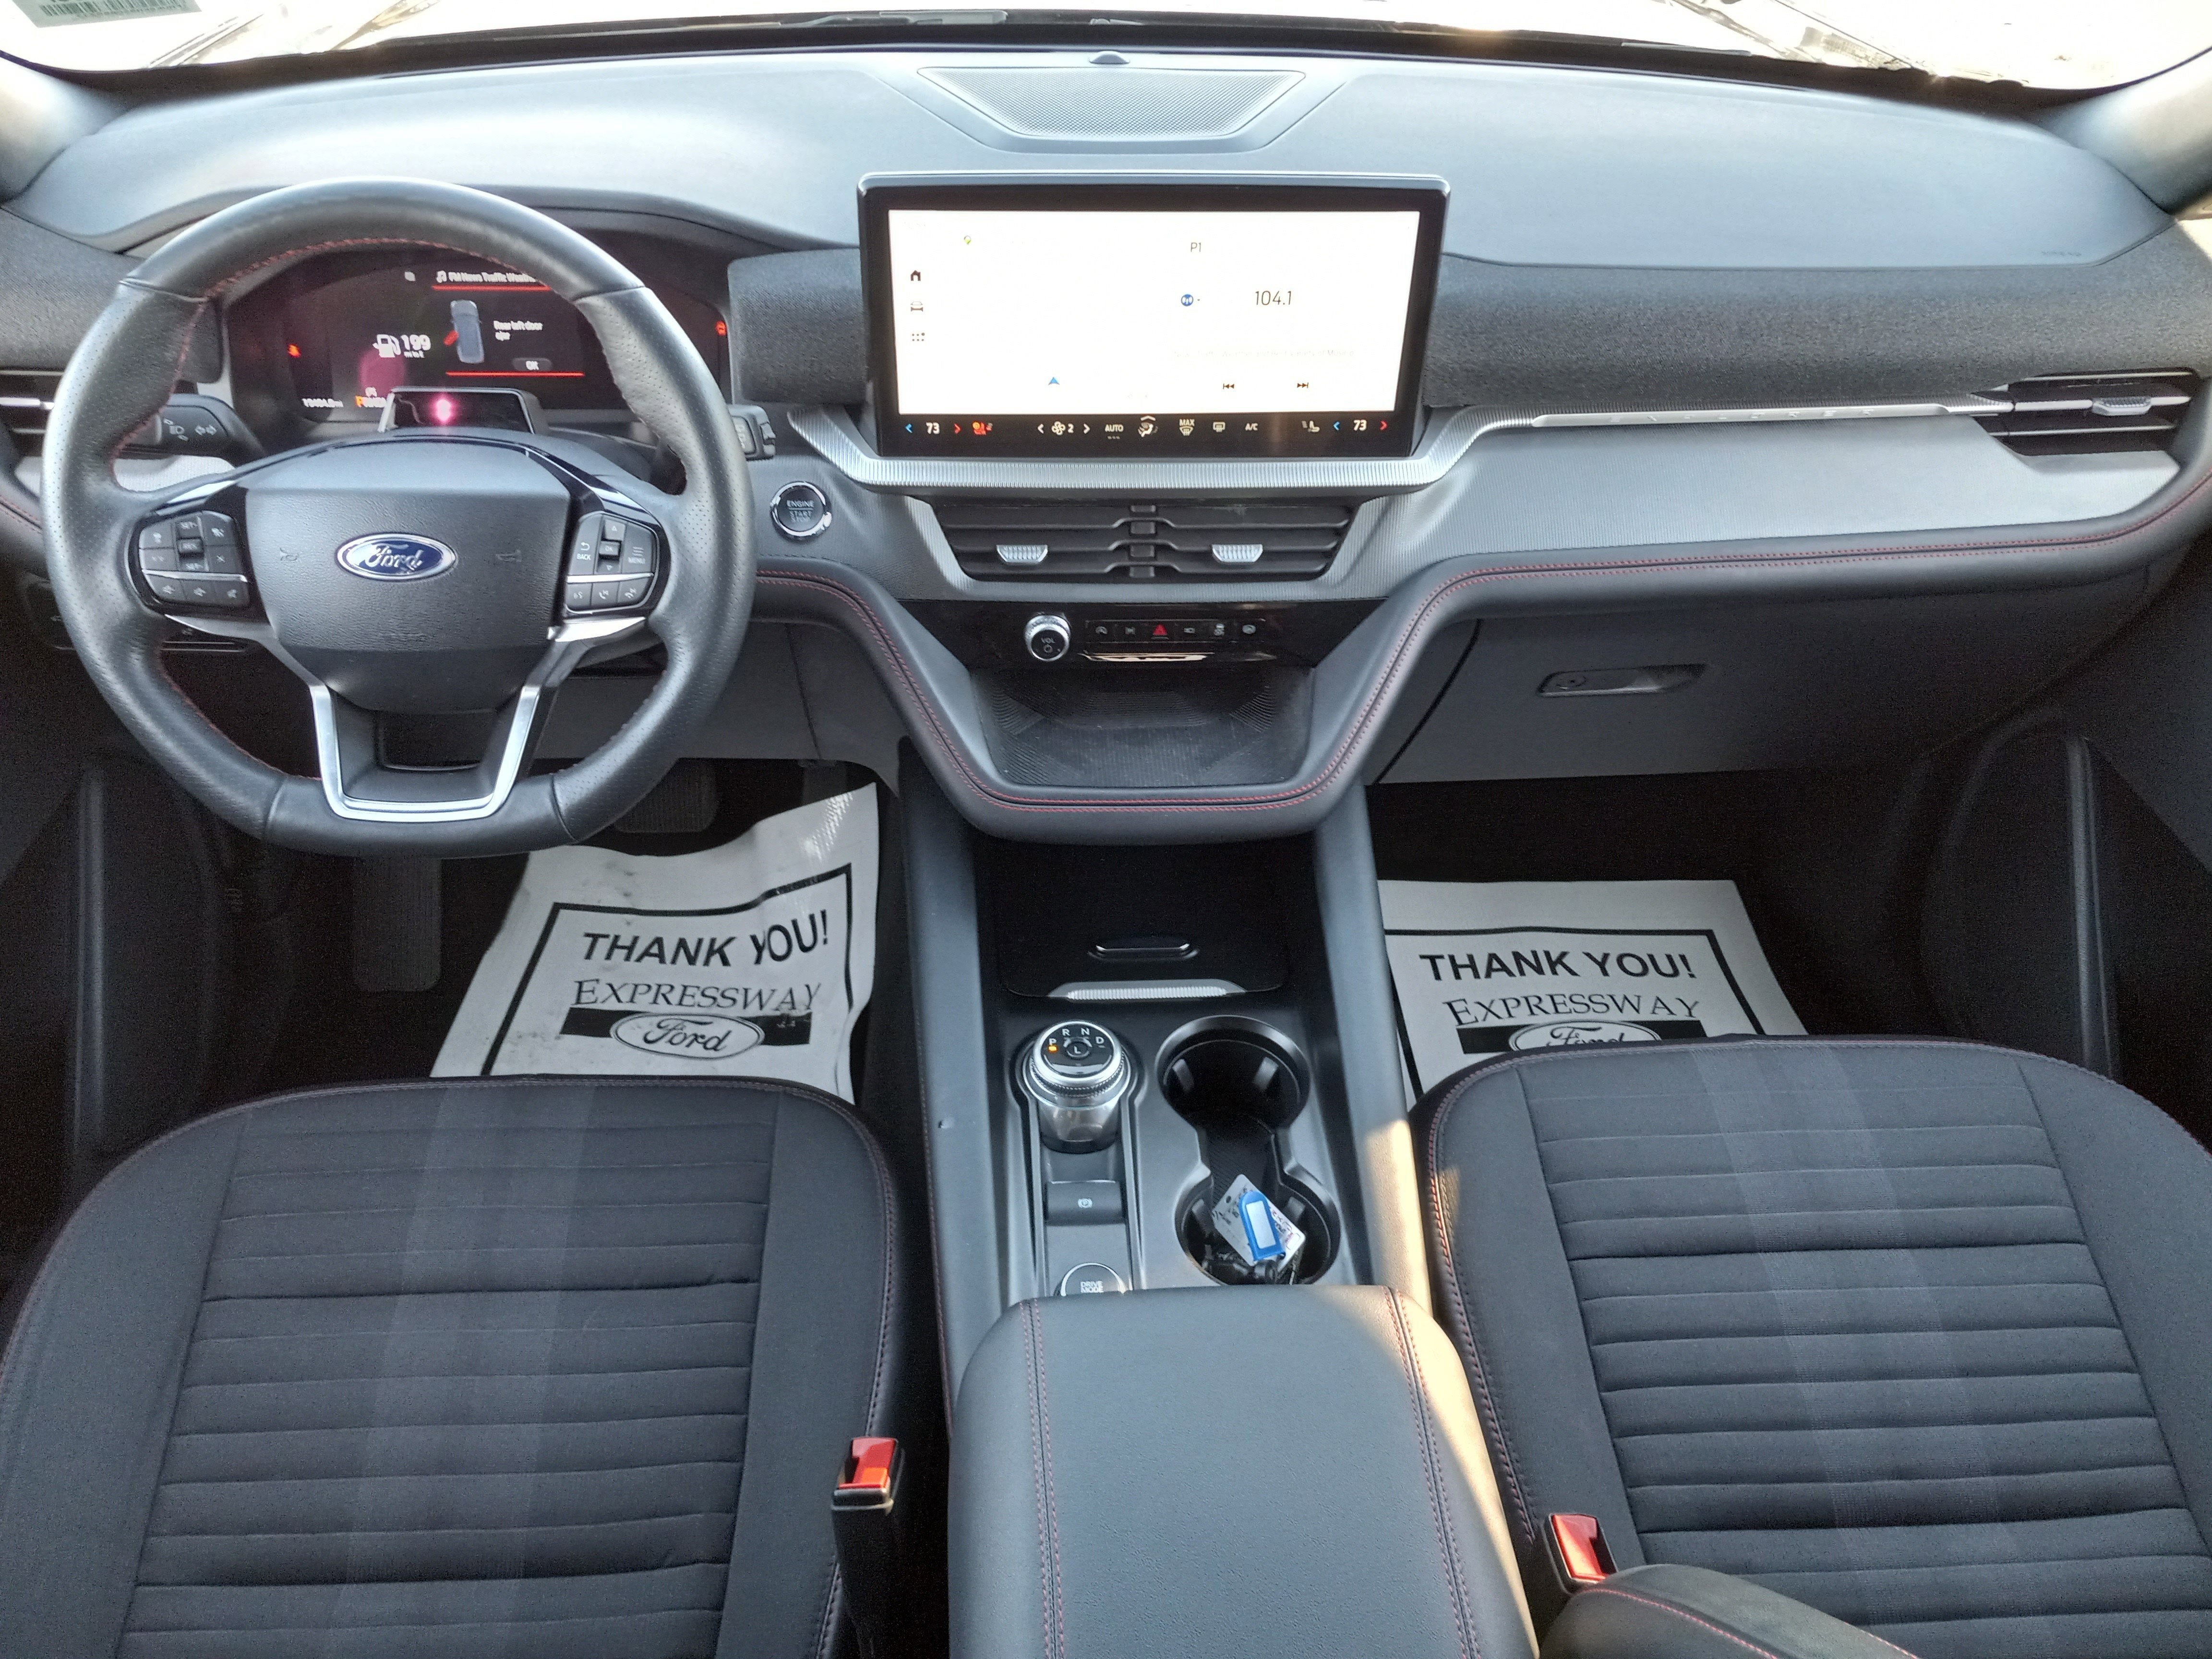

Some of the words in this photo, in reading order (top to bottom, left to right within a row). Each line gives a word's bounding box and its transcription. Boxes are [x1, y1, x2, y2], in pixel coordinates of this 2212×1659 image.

[1190, 242, 1201, 252] P1
[1255, 290, 1292, 306] 104.1
[400, 334, 431, 350] 199
[526, 361, 539, 370] OK
[926, 422, 940, 434] 73
[1067, 423, 1074, 433] 2
[1105, 424, 1124, 433] AUTO
[1179, 419, 1195, 427] MAX
[1353, 419, 1367, 431] 73
[365, 543, 423, 571] Ford
[583, 932, 737, 967] THANK
[750, 909, 828, 965] YOU!
[1419, 950, 1580, 981] THANK
[1583, 952, 1697, 978] YOU!
[574, 978, 821, 1011] EXPRESSWAY
[1442, 993, 1700, 1026] EXPRESSWAY
[643, 1017, 733, 1053] Ford
[1081, 1027, 1090, 1035] N
[1073, 1046, 1081, 1054] L
